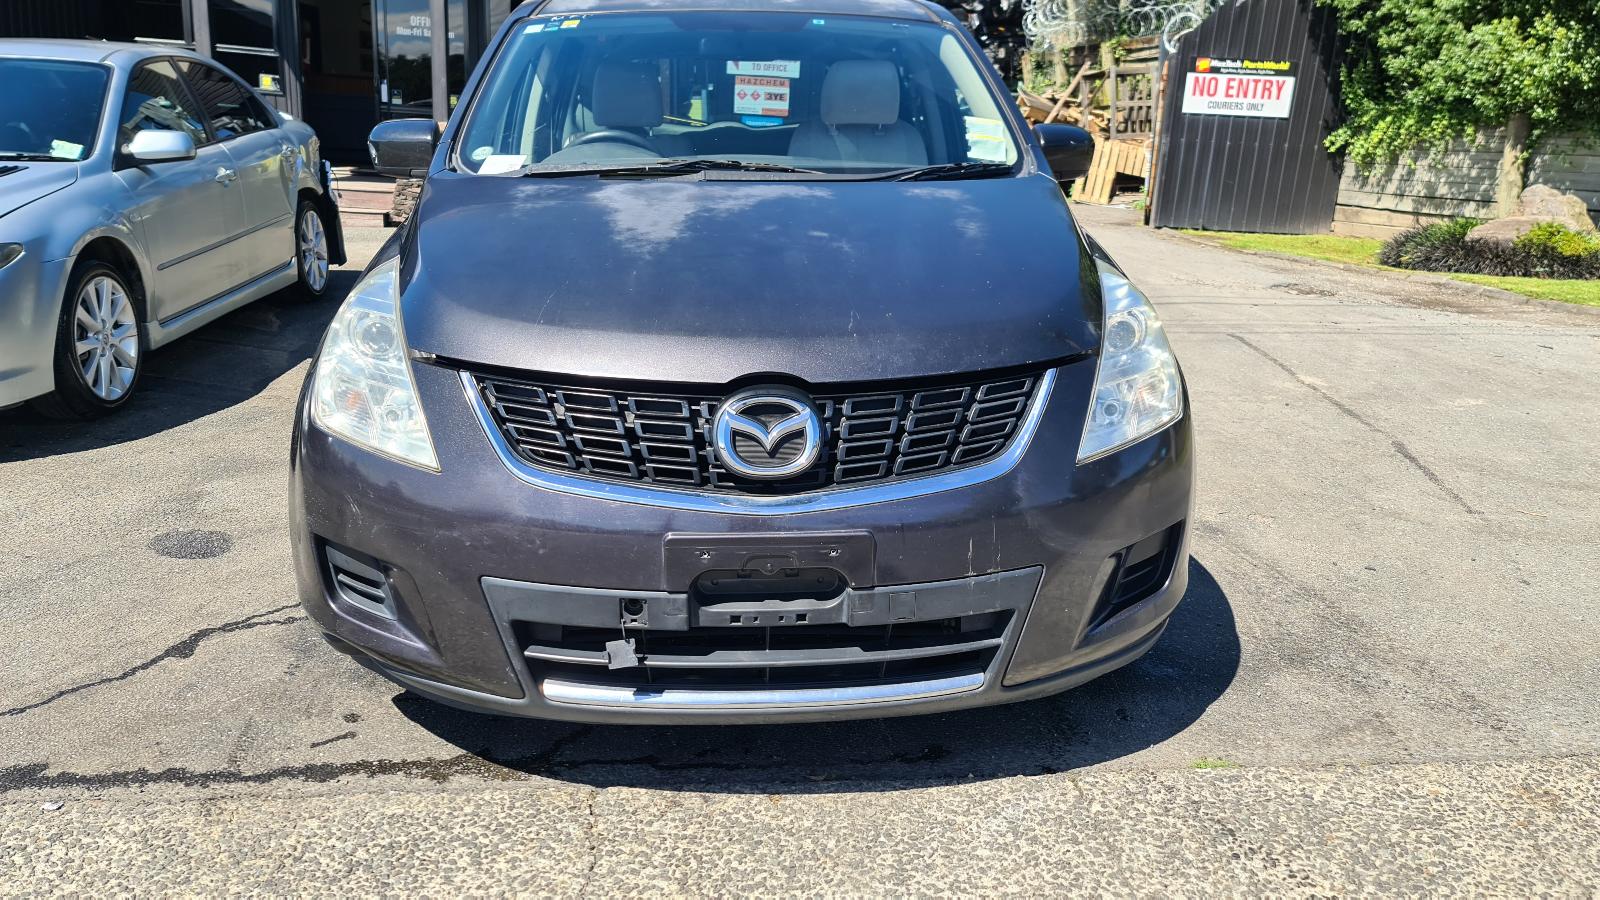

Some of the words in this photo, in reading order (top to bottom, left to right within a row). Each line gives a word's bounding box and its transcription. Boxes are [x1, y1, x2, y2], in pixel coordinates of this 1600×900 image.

[410, 16, 431, 27] OFFI
[752, 63, 761, 71] TO
[763, 63, 788, 73] OFFICE
[740, 78, 786, 87] HAZCHEM
[1192, 76, 1218, 97] NO
[1224, 78, 1286, 100] ENTRY
[767, 93, 785, 101] 3YE
[1207, 100, 1245, 111] COURIERS
[1246, 102, 1265, 112] ONLY
